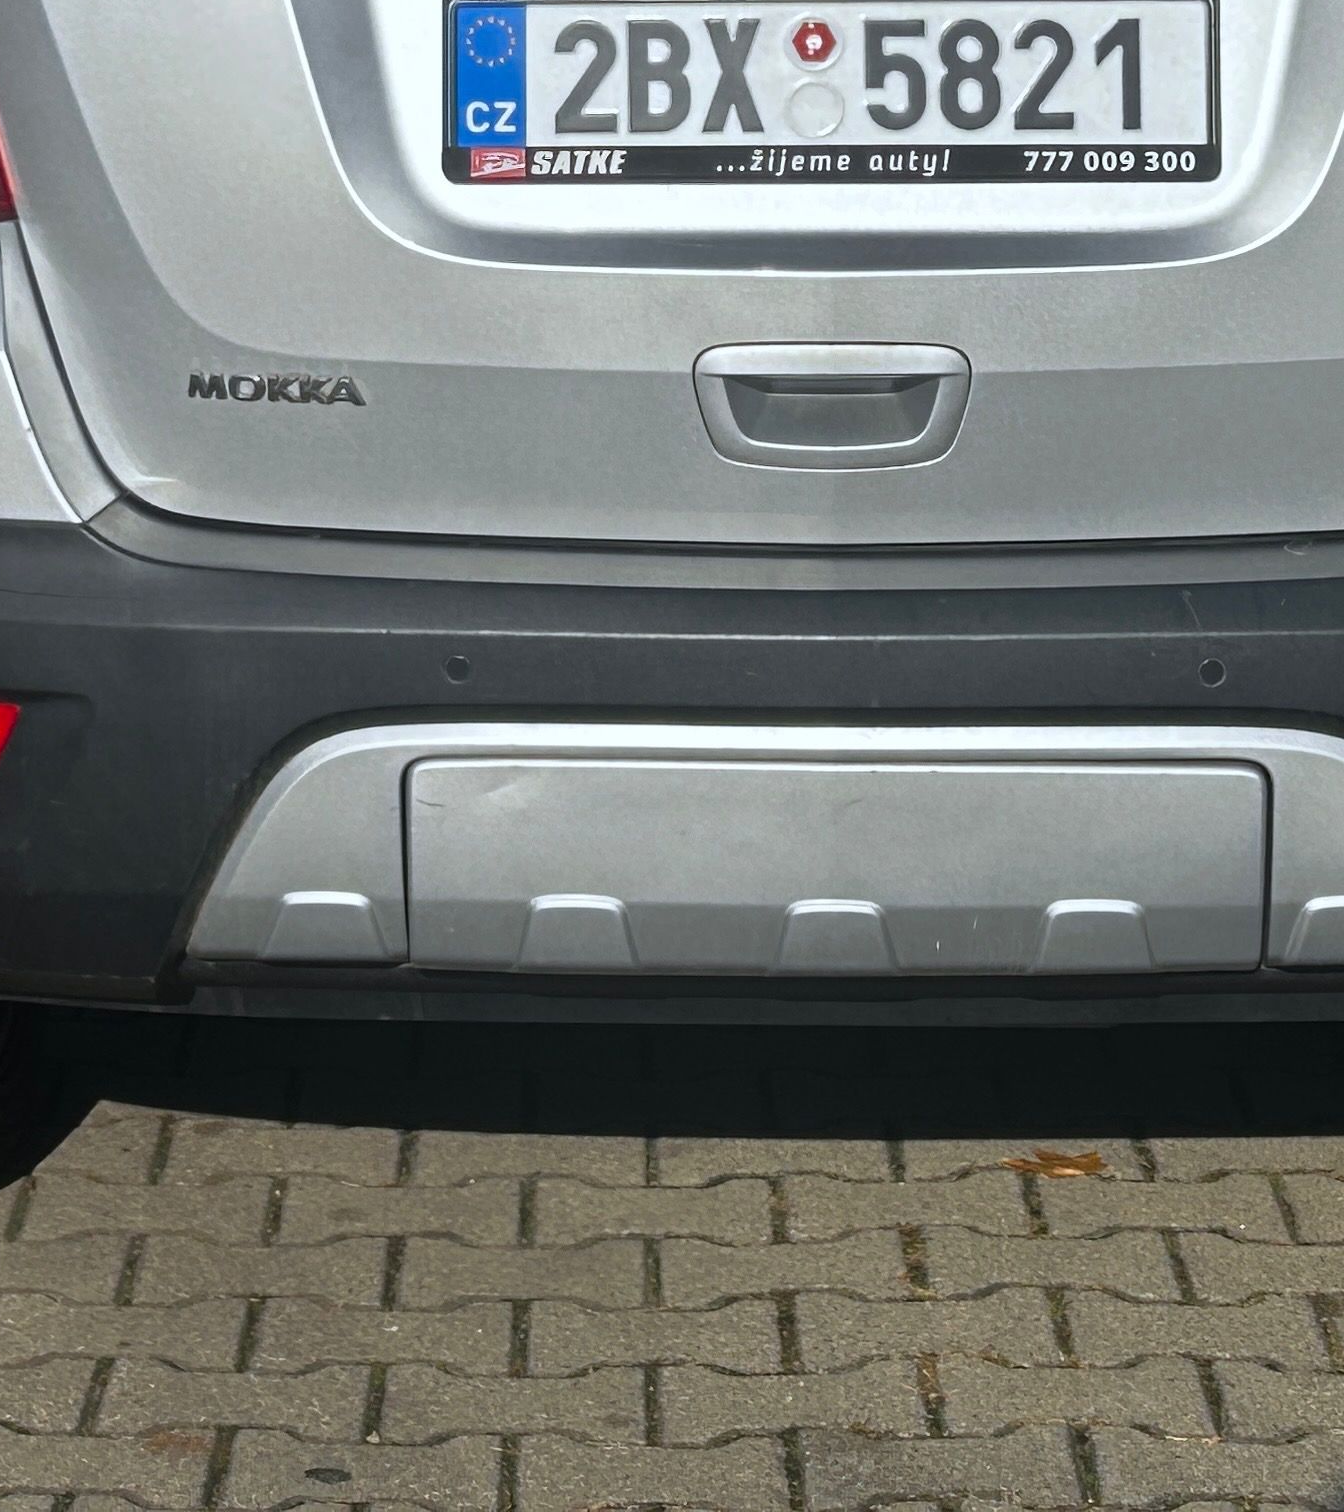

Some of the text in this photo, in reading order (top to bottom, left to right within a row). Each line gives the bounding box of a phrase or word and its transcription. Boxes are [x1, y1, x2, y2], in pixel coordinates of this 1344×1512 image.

[554, 18, 1142, 134] 2BX 5821
[465, 101, 517, 133] CZ
[531, 149, 627, 175] SATKE
[869, 149, 951, 177] auty!
[1023, 150, 1196, 173] 777 009 300
[188, 373, 367, 406] MOKKA
